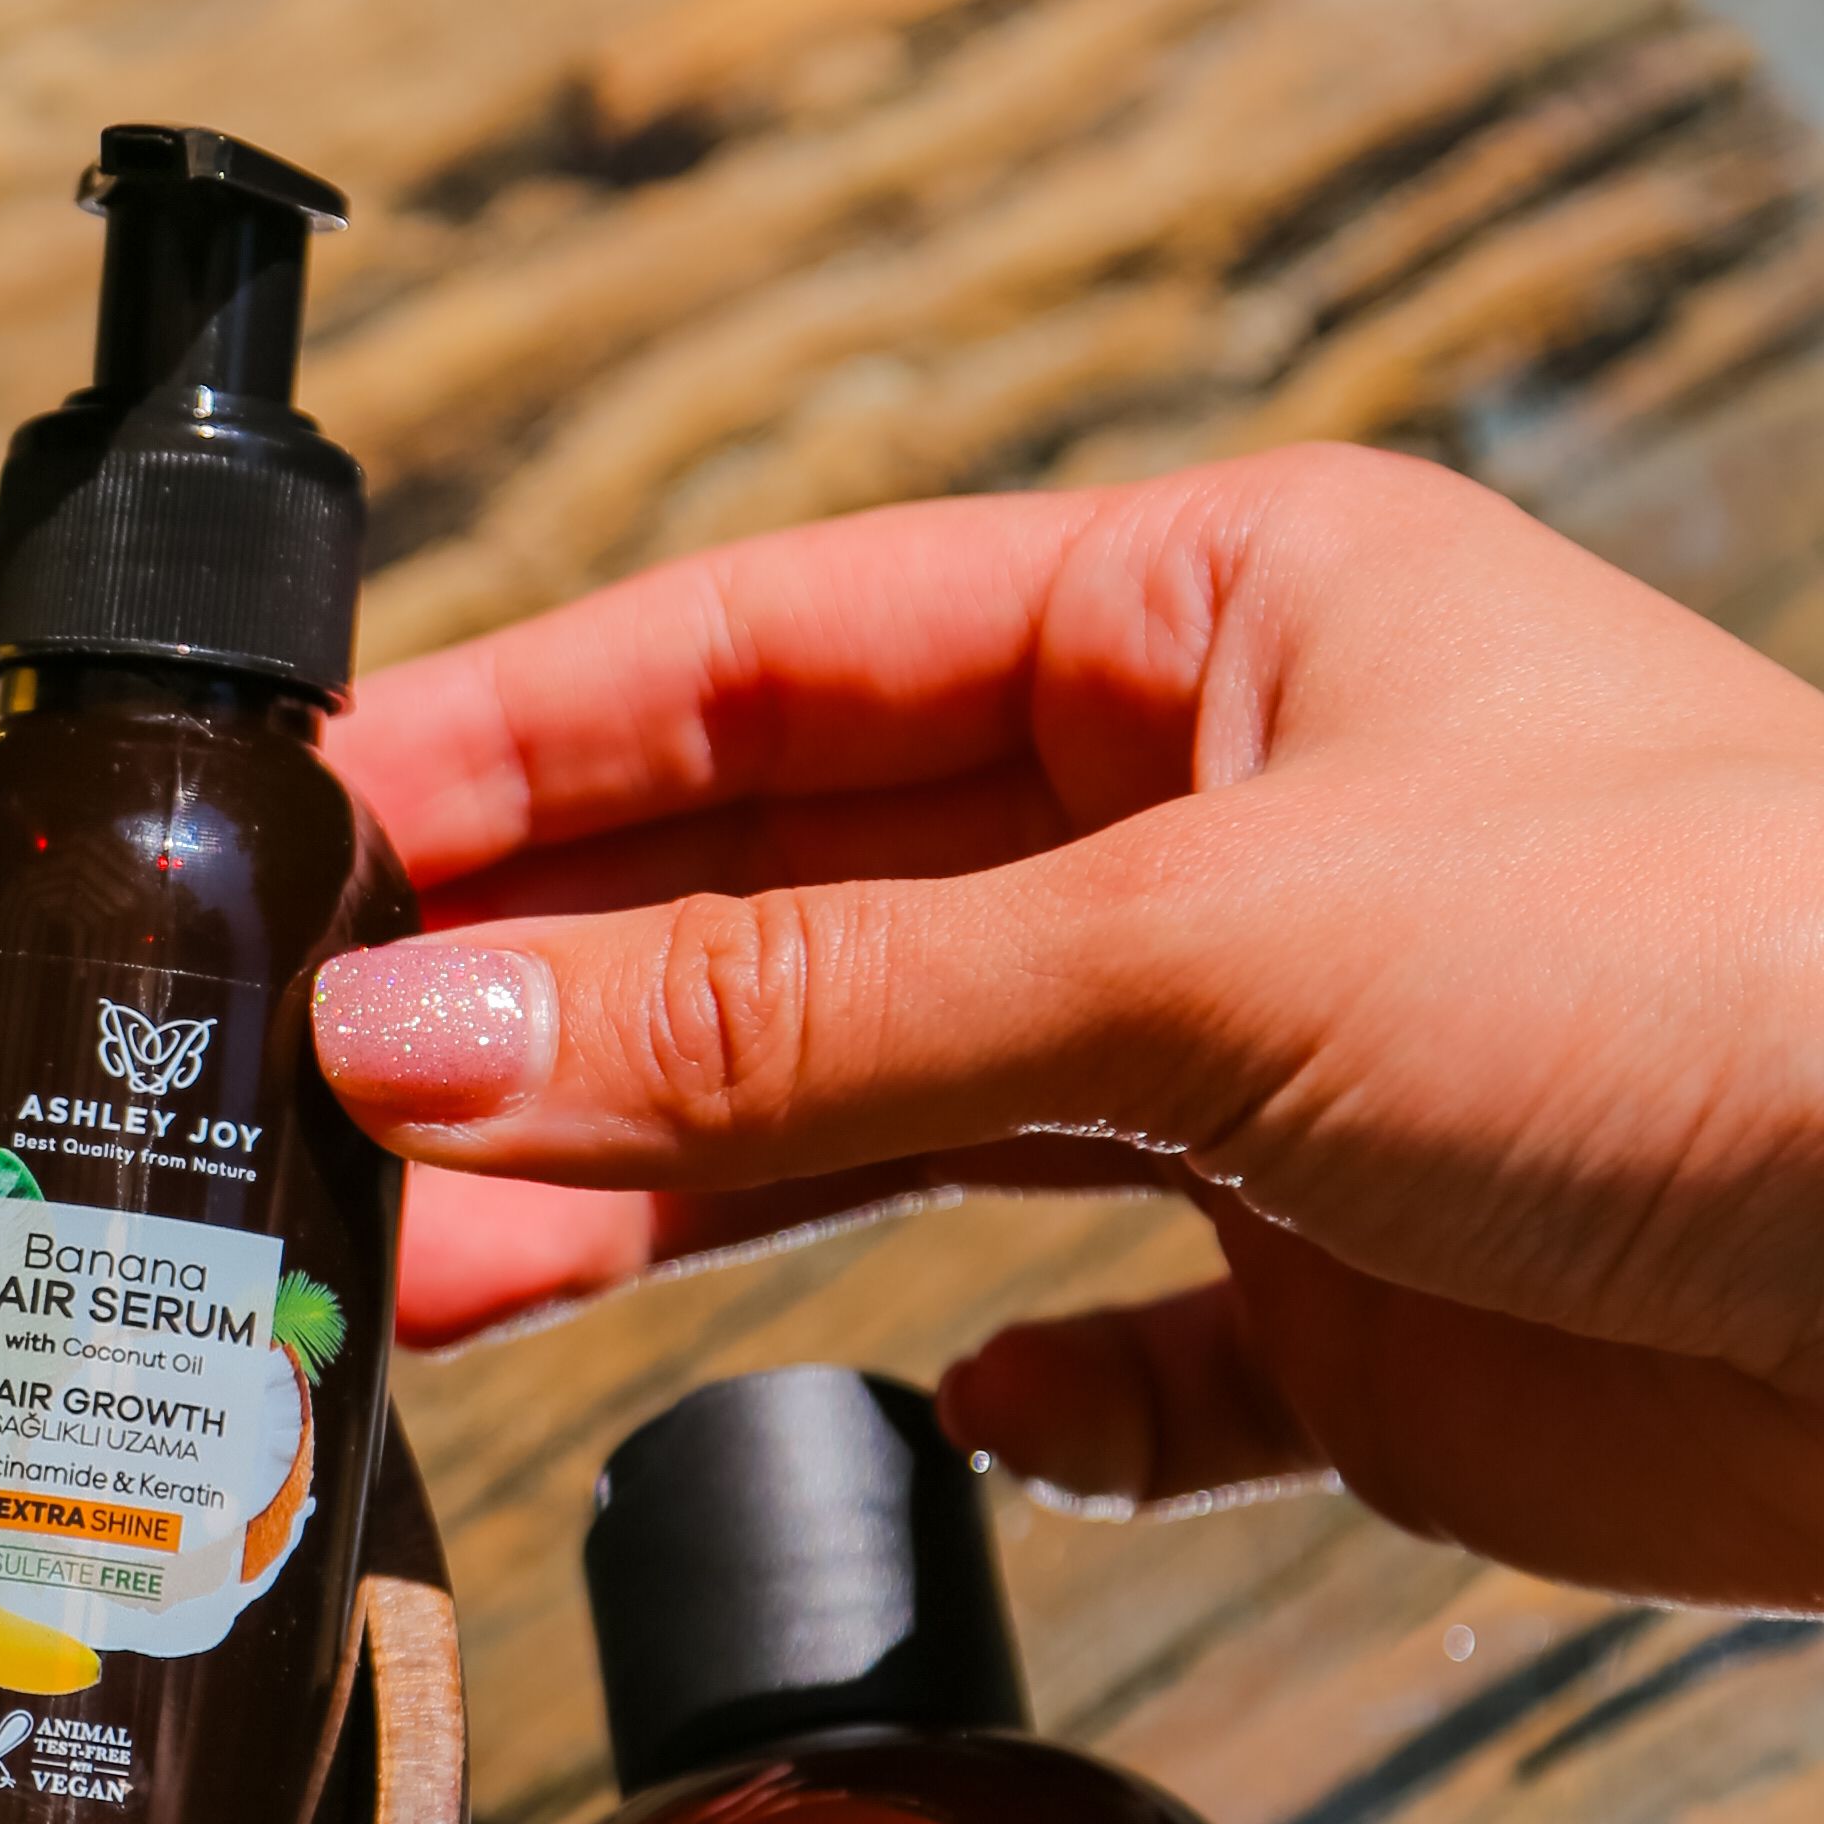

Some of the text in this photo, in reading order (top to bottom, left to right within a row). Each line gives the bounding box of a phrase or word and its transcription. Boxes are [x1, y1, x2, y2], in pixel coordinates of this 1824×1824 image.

[18, 1093, 263, 1154] ASHLEY JOY
[13, 1132, 257, 1182] Best Quality from Nature
[24, 1232, 208, 1293] Banana
[88, 1286, 257, 1348] SERUM
[5, 1331, 205, 1376] with Coconut Oil
[63, 1387, 226, 1438] GROWTH
[107, 1428, 200, 1462] UZAMA
[113, 1471, 135, 1495] &
[139, 1473, 225, 1510] Keratin
[90, 1509, 170, 1542] SHINE
[100, 1565, 163, 1595] FREE
[33, 1737, 132, 1766] TEST-FREE
[36, 1717, 133, 1748] ANIMAL
[31, 1770, 127, 1803] VEGAN
